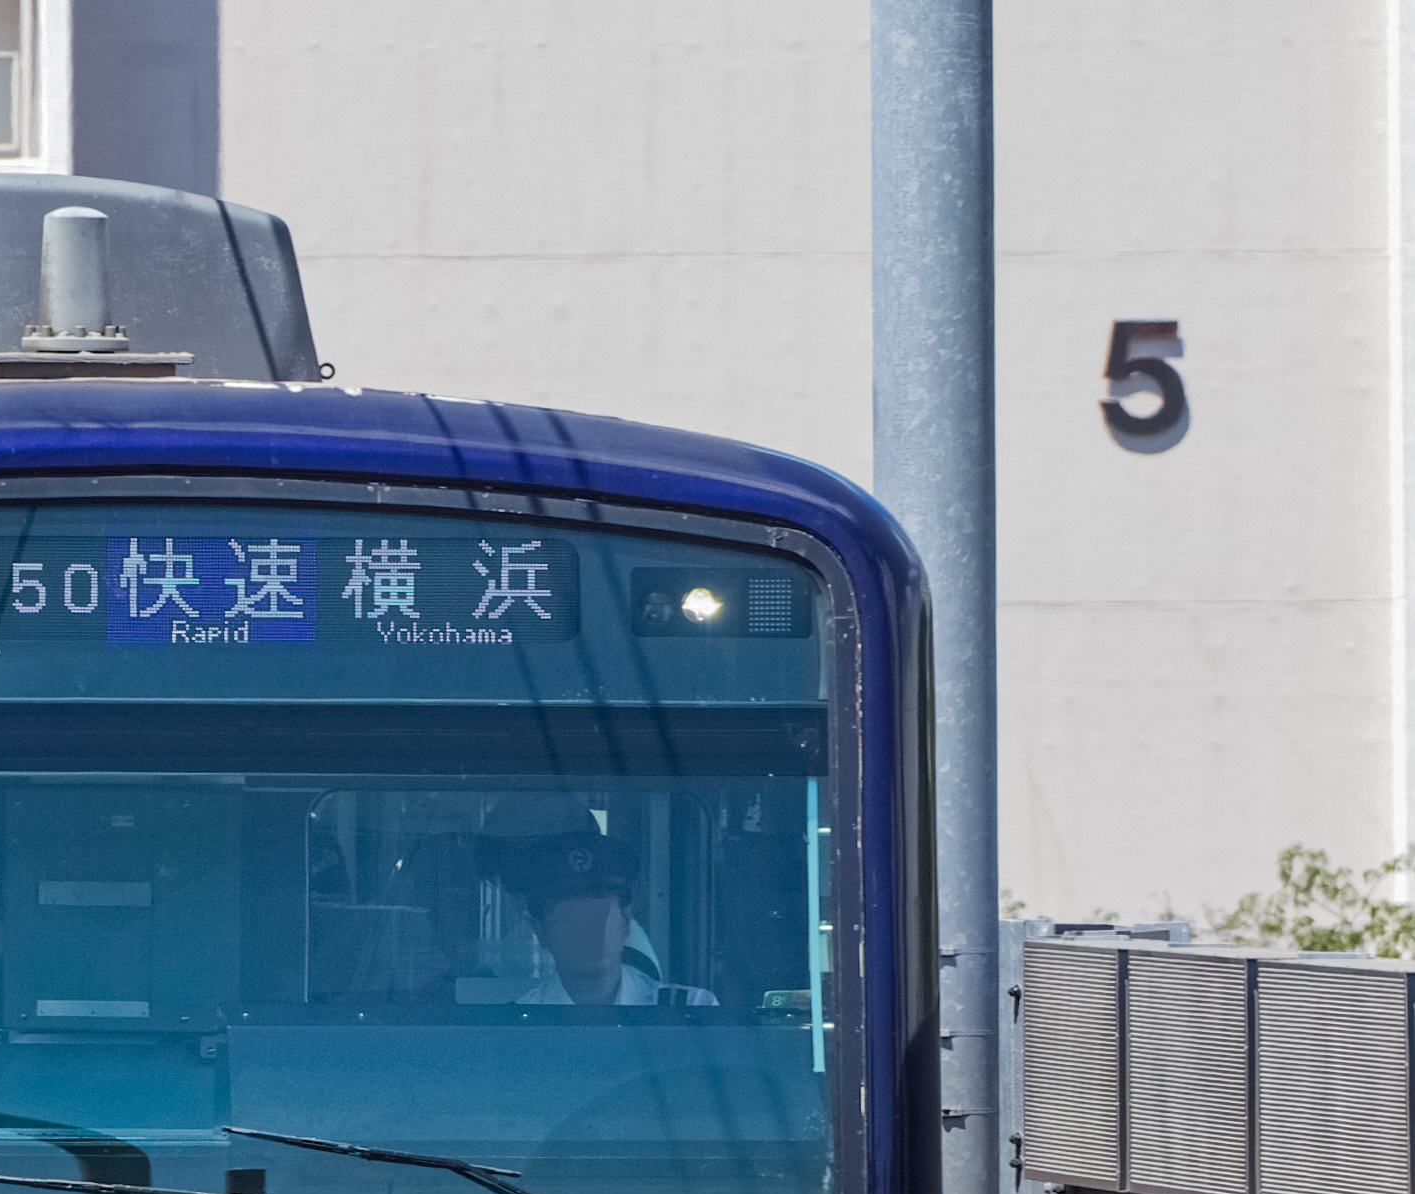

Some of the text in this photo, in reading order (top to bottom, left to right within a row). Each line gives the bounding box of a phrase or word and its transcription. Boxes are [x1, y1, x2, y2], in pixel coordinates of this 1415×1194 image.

[1099, 320, 1188, 454] 5
[12, 537, 553, 620] 50 快速 横浜
[171, 619, 514, 645] Rapid Yokohama
